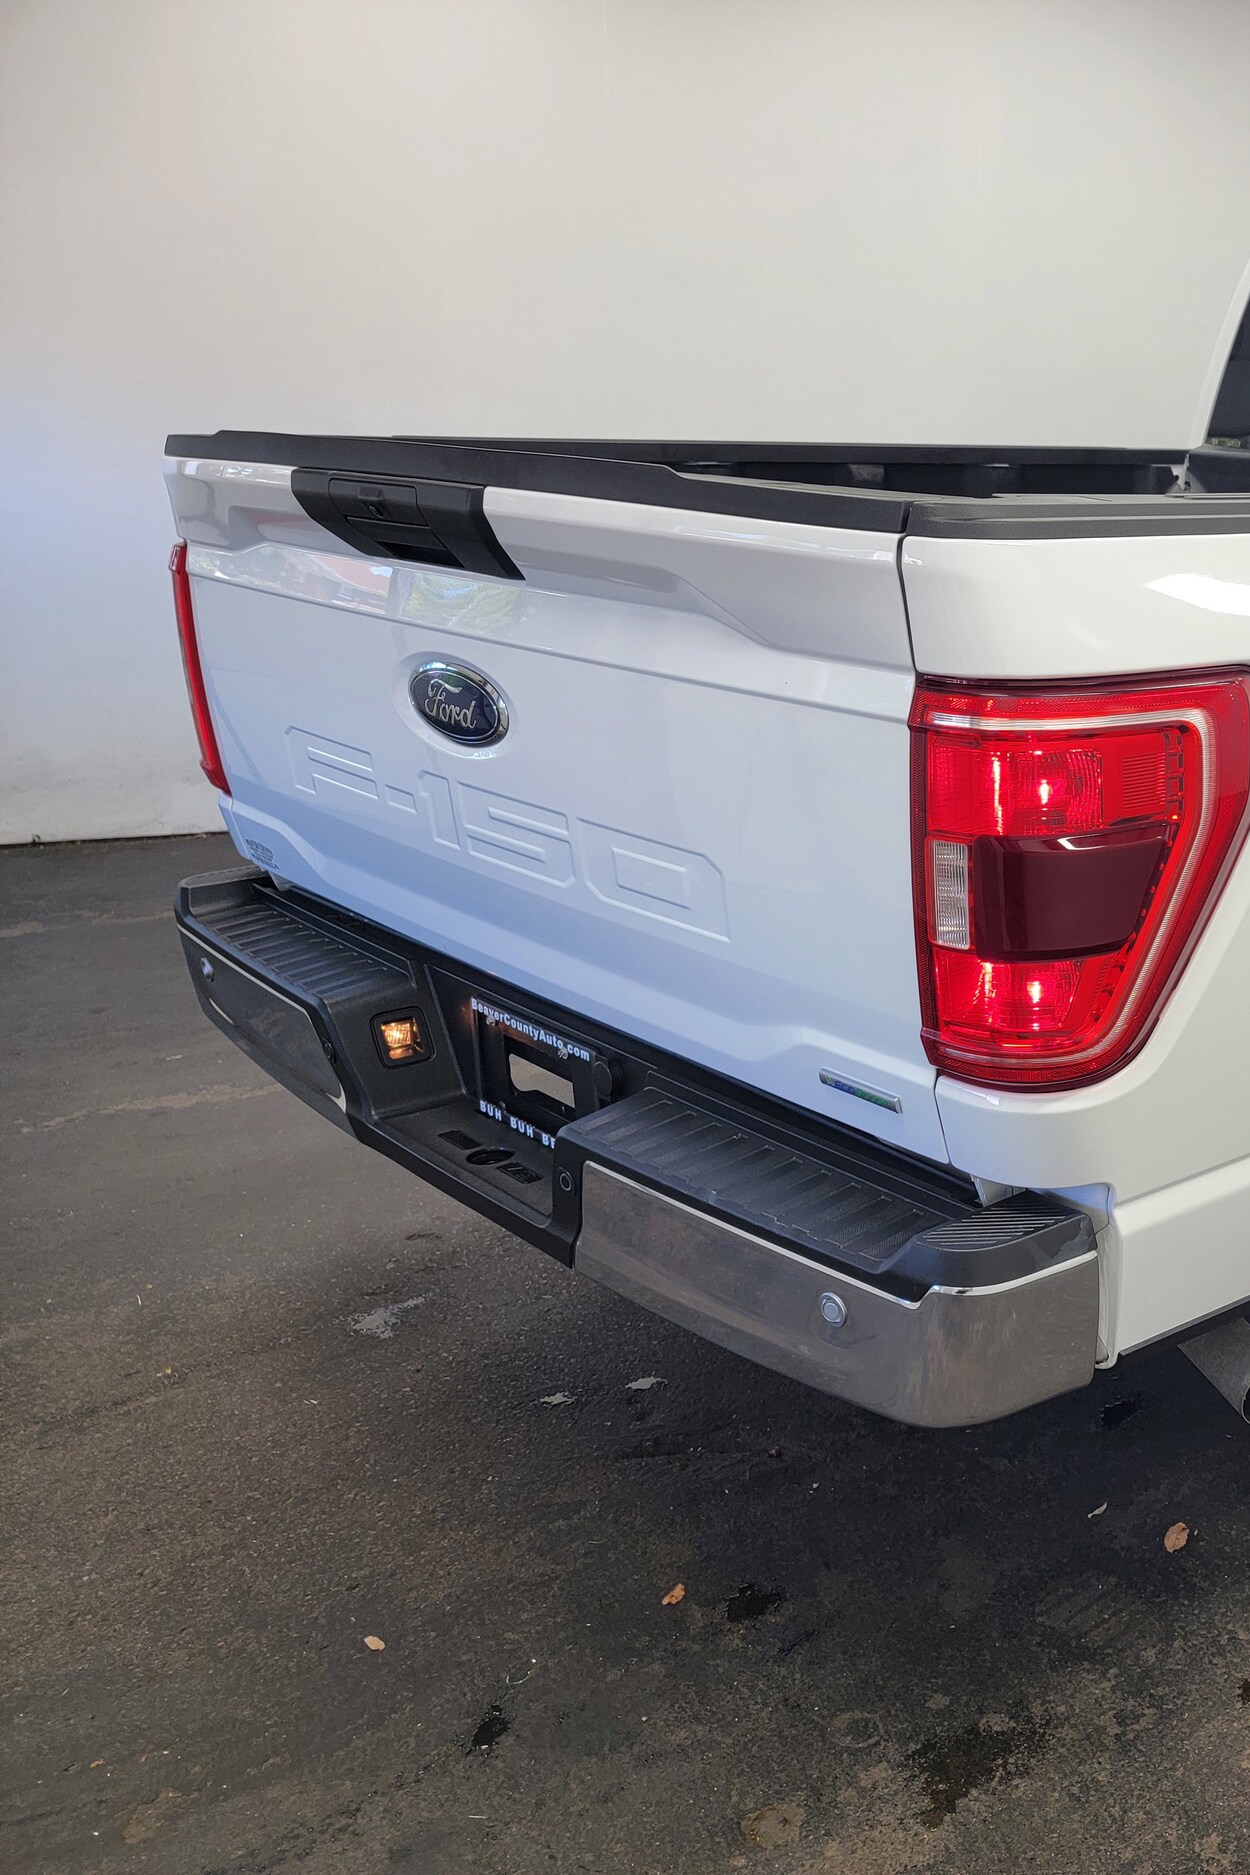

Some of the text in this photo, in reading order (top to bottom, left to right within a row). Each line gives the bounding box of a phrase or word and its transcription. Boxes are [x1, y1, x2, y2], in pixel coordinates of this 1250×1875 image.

[425, 678, 477, 729] Ford
[284, 725, 731, 944] F-150
[471, 997, 590, 1062] BeaverCountyAutocom
[479, 1100, 503, 1122] BUH
[510, 1116, 534, 1139] BUH
